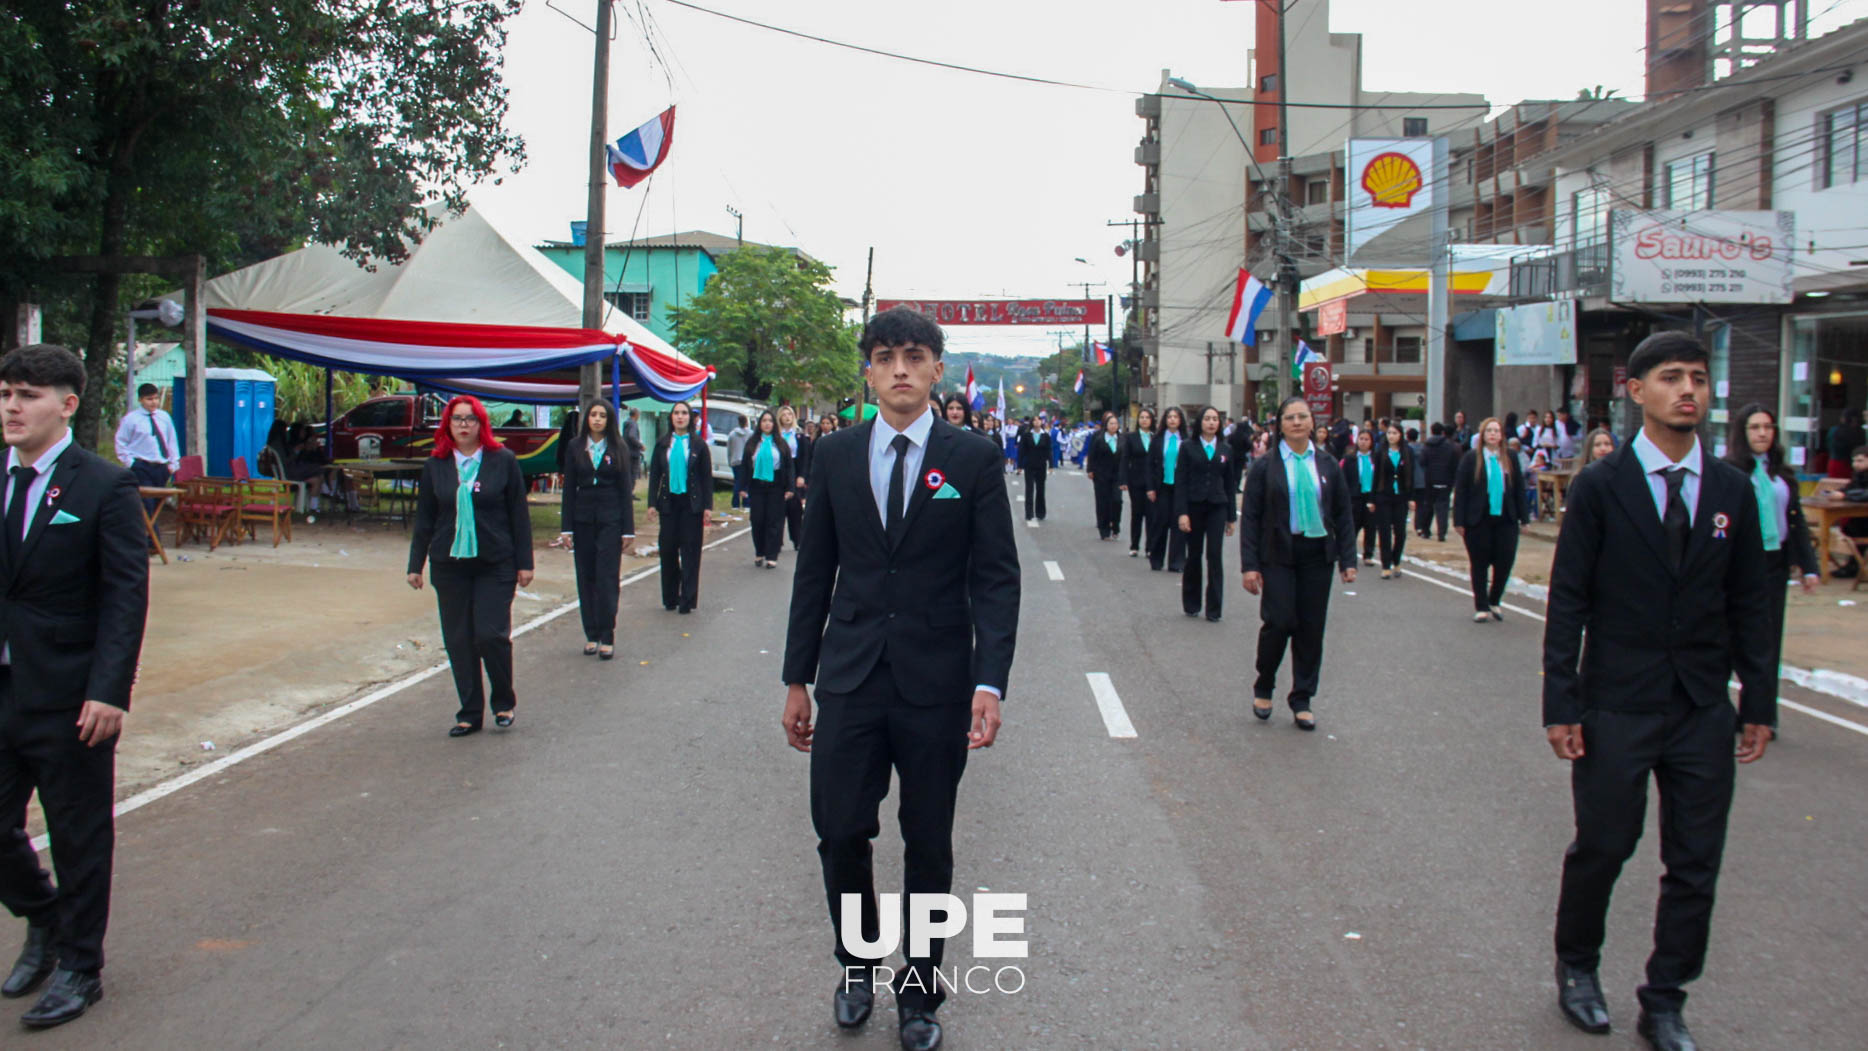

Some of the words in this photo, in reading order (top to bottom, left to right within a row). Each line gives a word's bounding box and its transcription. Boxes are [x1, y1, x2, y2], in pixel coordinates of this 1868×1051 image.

[1634, 224, 1773, 261] Sauro's
[1708, 269, 1727, 278] 275
[1729, 269, 1746, 278] 210
[1708, 283, 1727, 292] 275
[1729, 283, 1743, 292] 211
[924, 303, 1004, 322] HOTEL
